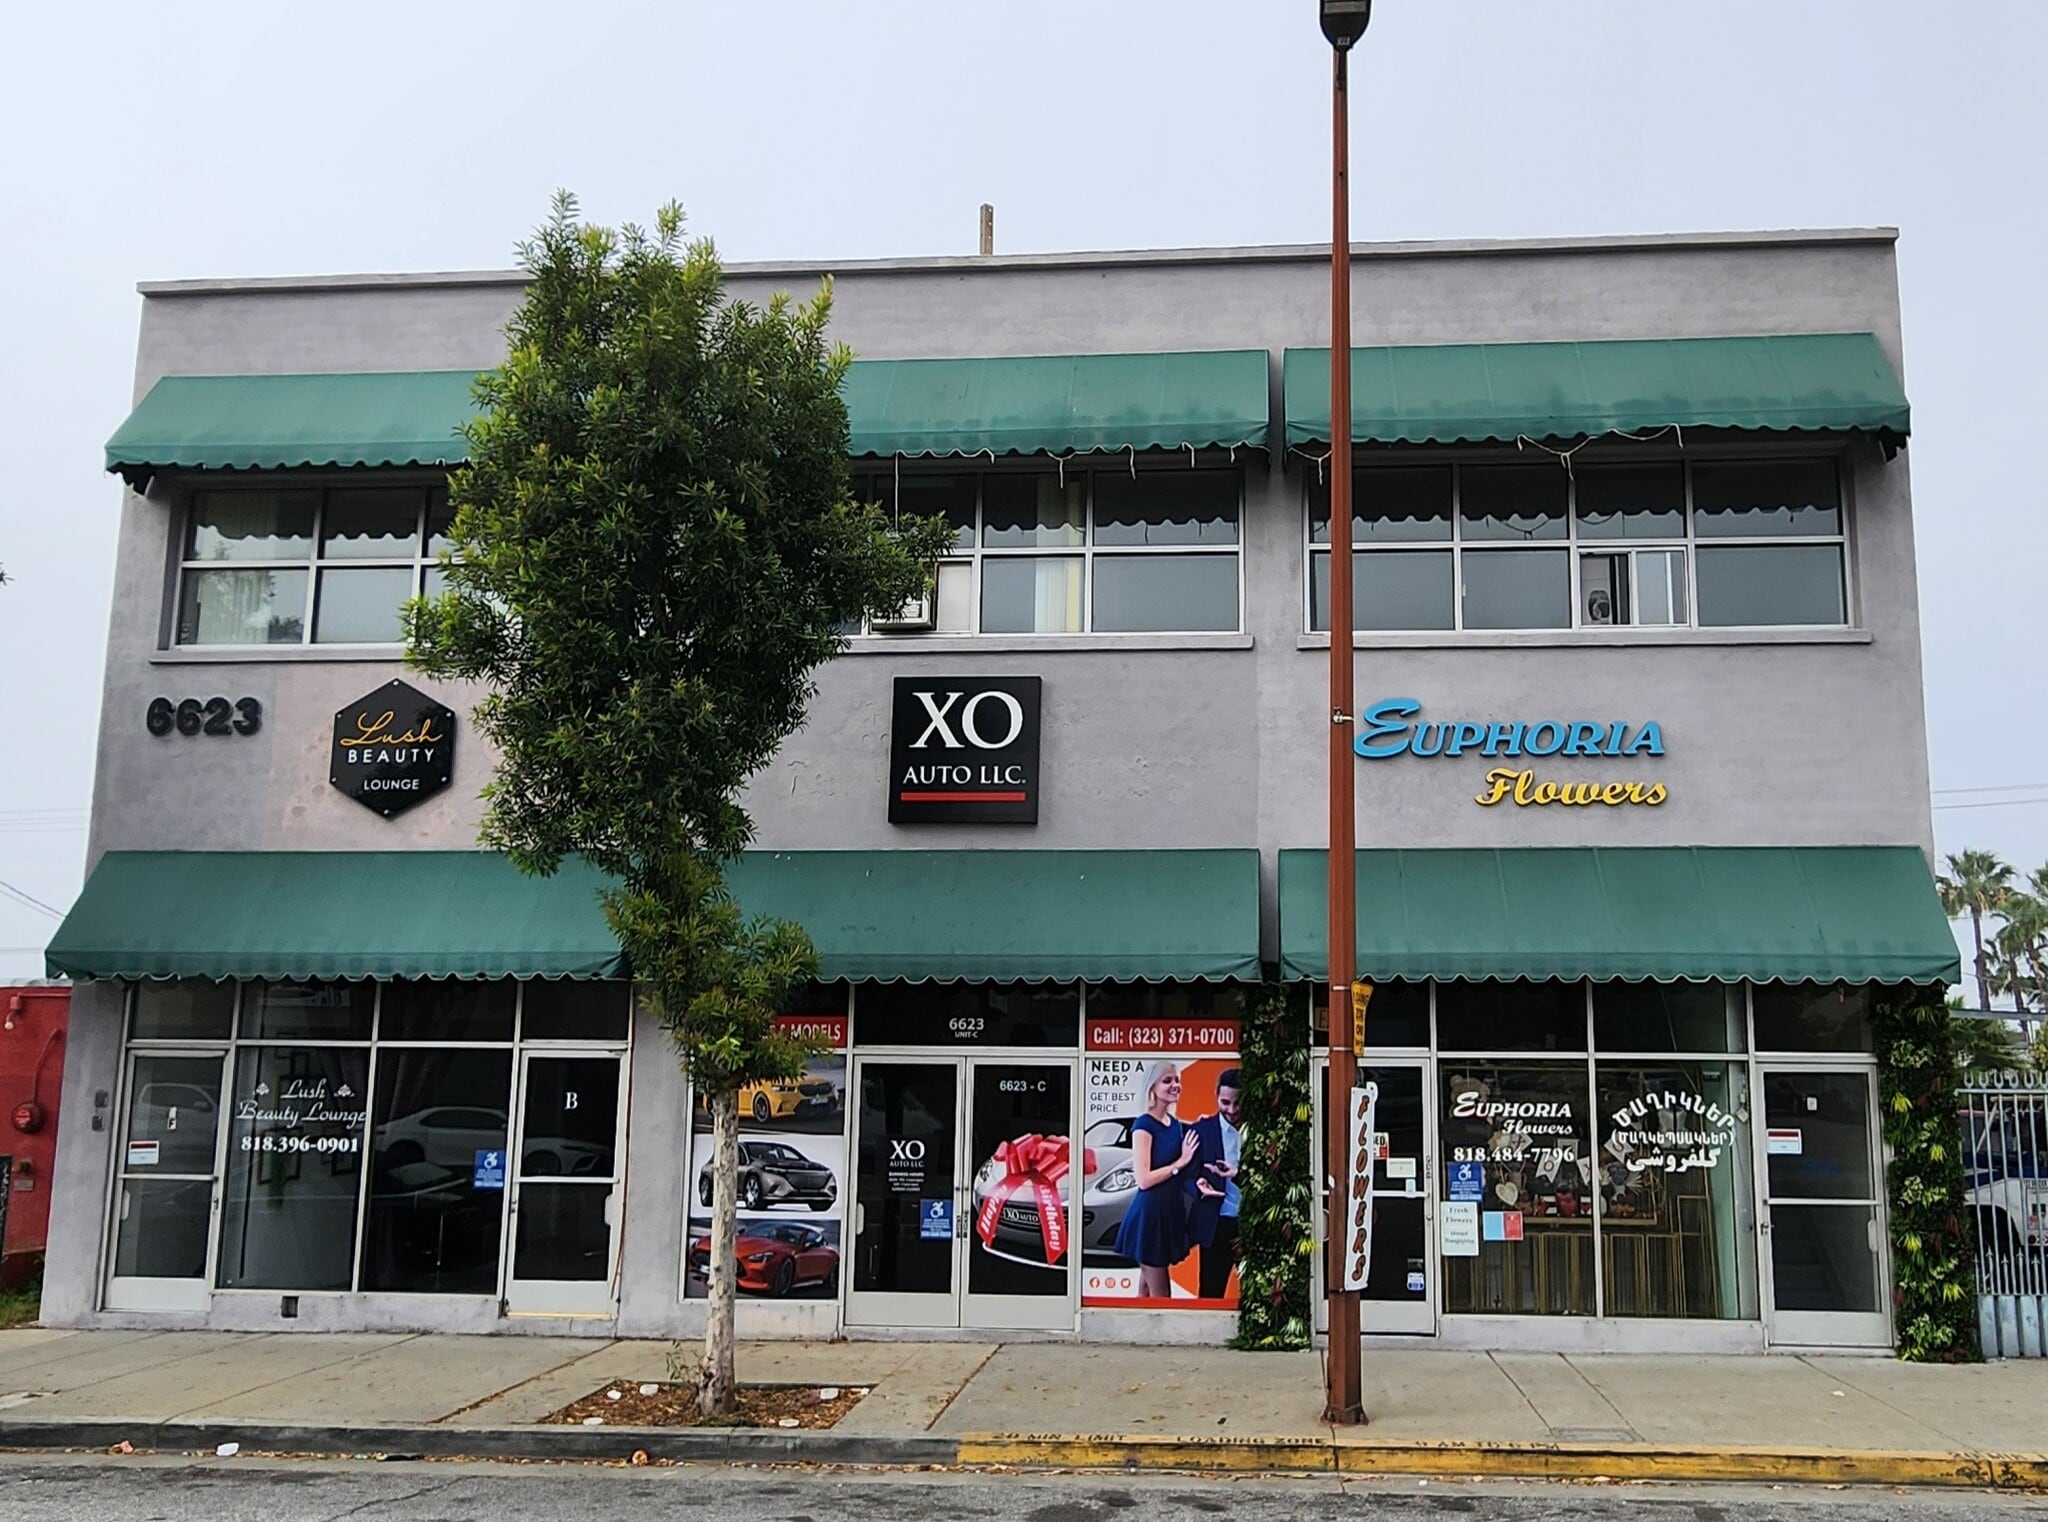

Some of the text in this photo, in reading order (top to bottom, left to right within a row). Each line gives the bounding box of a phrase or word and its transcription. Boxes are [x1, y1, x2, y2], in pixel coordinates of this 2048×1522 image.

[146, 697, 262, 737] 6623
[908, 691, 1024, 749] XO
[340, 711, 443, 746] Lush
[1353, 697, 1665, 758] EUPHORIA
[348, 749, 435, 764] BEAUTY
[903, 766, 972, 785] AUTO
[363, 778, 420, 791] LOUNGE
[1475, 768, 1668, 806] Flowers
[949, 1018, 985, 1031] 6623
[954, 1031, 978, 1039] UNIT-C
[1093, 1027, 1235, 1047] Call: (323) 371-0700
[1091, 1060, 1145, 1073] NEED A
[280, 1078, 327, 1099] Lush
[999, 1080, 1027, 1092] 6623
[1037, 1081, 1047, 1092] C
[1091, 1075, 1129, 1087] CAR?
[564, 1092, 578, 1110] B
[1090, 1092, 1136, 1101] GET BEST
[236, 1100, 367, 1129] Beauty Lounge
[1090, 1104, 1119, 1113] PRICE
[1501, 1119, 1573, 1135] Flowers
[241, 1136, 359, 1152] 818.396-0901
[889, 1140, 925, 1160] XO
[1454, 1146, 1575, 1162] 818.484-7796
[1352, 1094, 1370, 1281] FLOWERS
